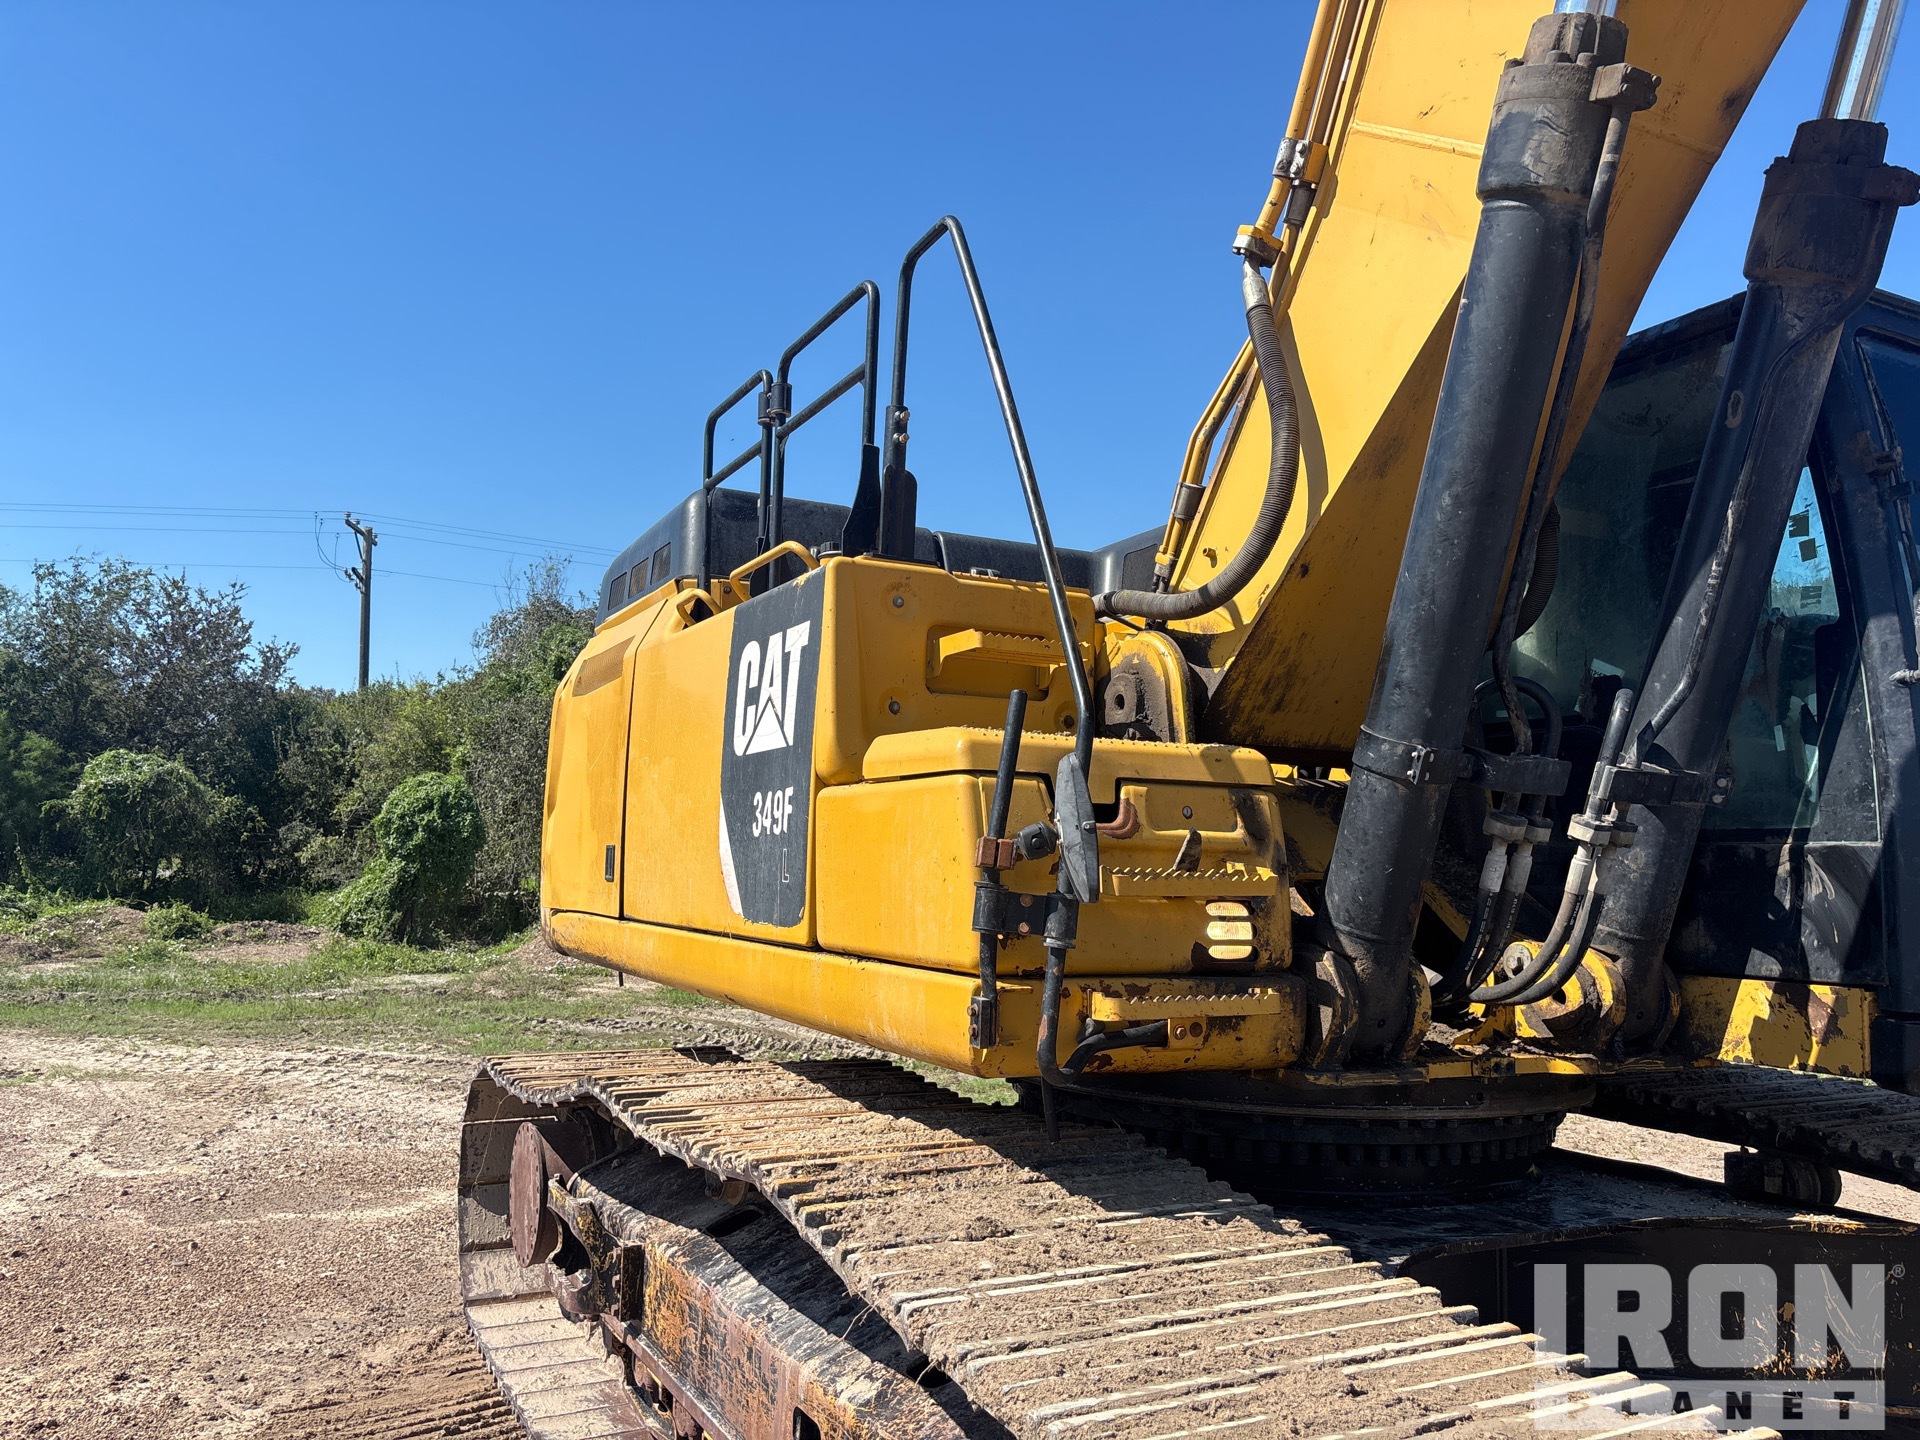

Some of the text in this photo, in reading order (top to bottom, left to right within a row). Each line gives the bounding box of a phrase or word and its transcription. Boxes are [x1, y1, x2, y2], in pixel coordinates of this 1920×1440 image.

[733, 620, 811, 756] CAT
[752, 786, 794, 838] 349F
[781, 848, 790, 883] L
